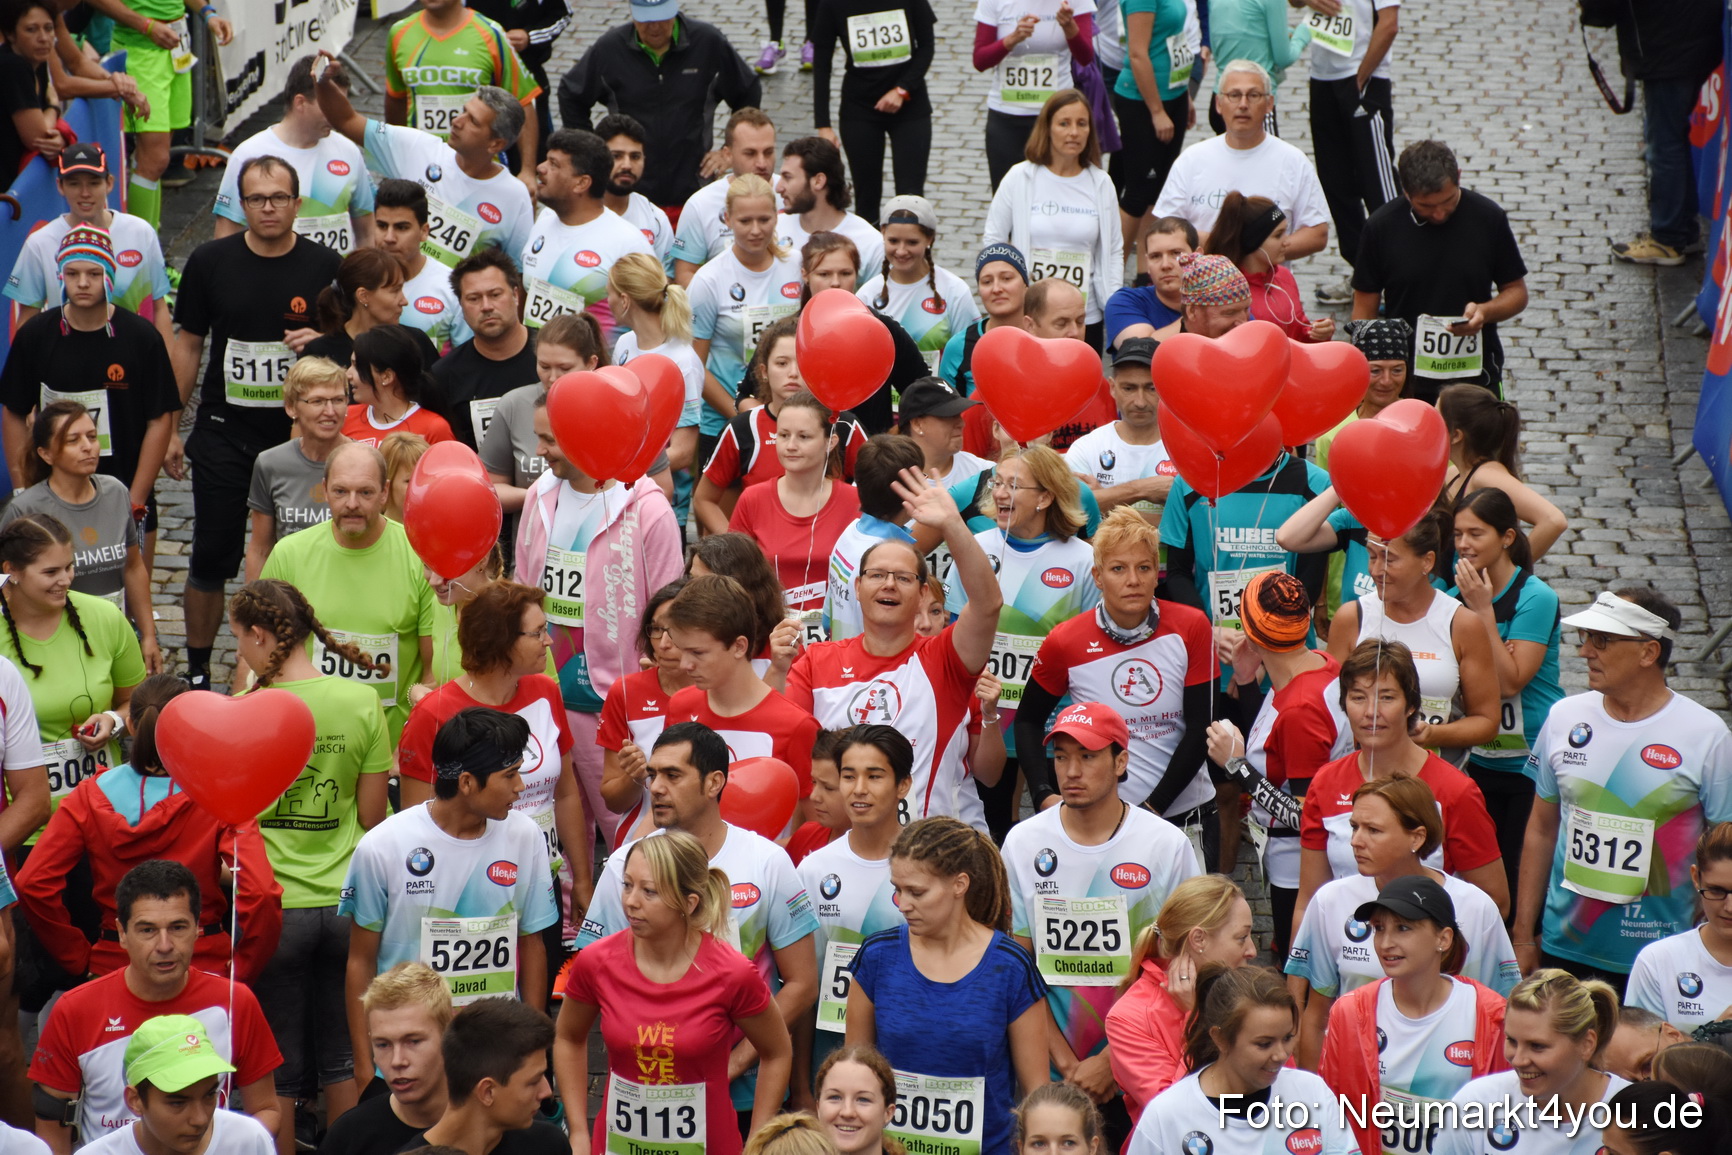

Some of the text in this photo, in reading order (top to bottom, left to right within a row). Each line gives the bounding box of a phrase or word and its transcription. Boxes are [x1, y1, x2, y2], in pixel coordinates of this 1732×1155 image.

[1310, 12, 1352, 36] 5150
[857, 24, 903, 47] 5133
[402, 66, 482, 87] BOCK
[1006, 67, 1052, 87] 5012
[1016, 91, 1040, 100] Esther
[428, 213, 471, 252] 246
[420, 242, 442, 259] Anas
[1032, 261, 1084, 287] 5279
[418, 300, 441, 311] Hervis
[232, 357, 289, 382] 5115
[1431, 360, 1467, 371] Andreas
[243, 387, 279, 398] Norbert
[1045, 573, 1070, 584] Hervis
[793, 588, 814, 599] DEHN
[552, 602, 581, 616] Haserl
[1060, 714, 1092, 726] DEKRA
[1563, 751, 1587, 761] PARTL
[1646, 748, 1677, 764] Hervis
[526, 781, 540, 790] MIT
[293, 820, 338, 829] Gartenservice
[1597, 815, 1645, 833] BOCK
[1572, 828, 1643, 872] 5312
[492, 866, 518, 880] Hervis
[1116, 868, 1147, 882] Hervis
[406, 881, 435, 889] PARTL
[1035, 881, 1059, 889] PARTL
[819, 904, 840, 912] PARTL
[1071, 900, 1118, 911] BOCK
[1622, 904, 1645, 919] 17.
[467, 919, 510, 932] BOCK
[1621, 919, 1672, 929] Neumarkter
[1046, 918, 1121, 952] 5225
[1620, 929, 1660, 939] Stadtlauf
[432, 936, 510, 972] 5226
[1342, 946, 1370, 956] PARTL
[1343, 954, 1370, 962] Neumarkt
[1055, 959, 1114, 974] Chodadad
[452, 978, 486, 994] Javad
[1678, 1001, 1704, 1010] PARTL
[637, 1024, 675, 1046] WE
[925, 1079, 976, 1091] BOCK
[646, 1087, 696, 1099] BOCK
[615, 1099, 696, 1139] 5113
[890, 1093, 973, 1134] 5050
[1291, 1137, 1322, 1149] Hervis
